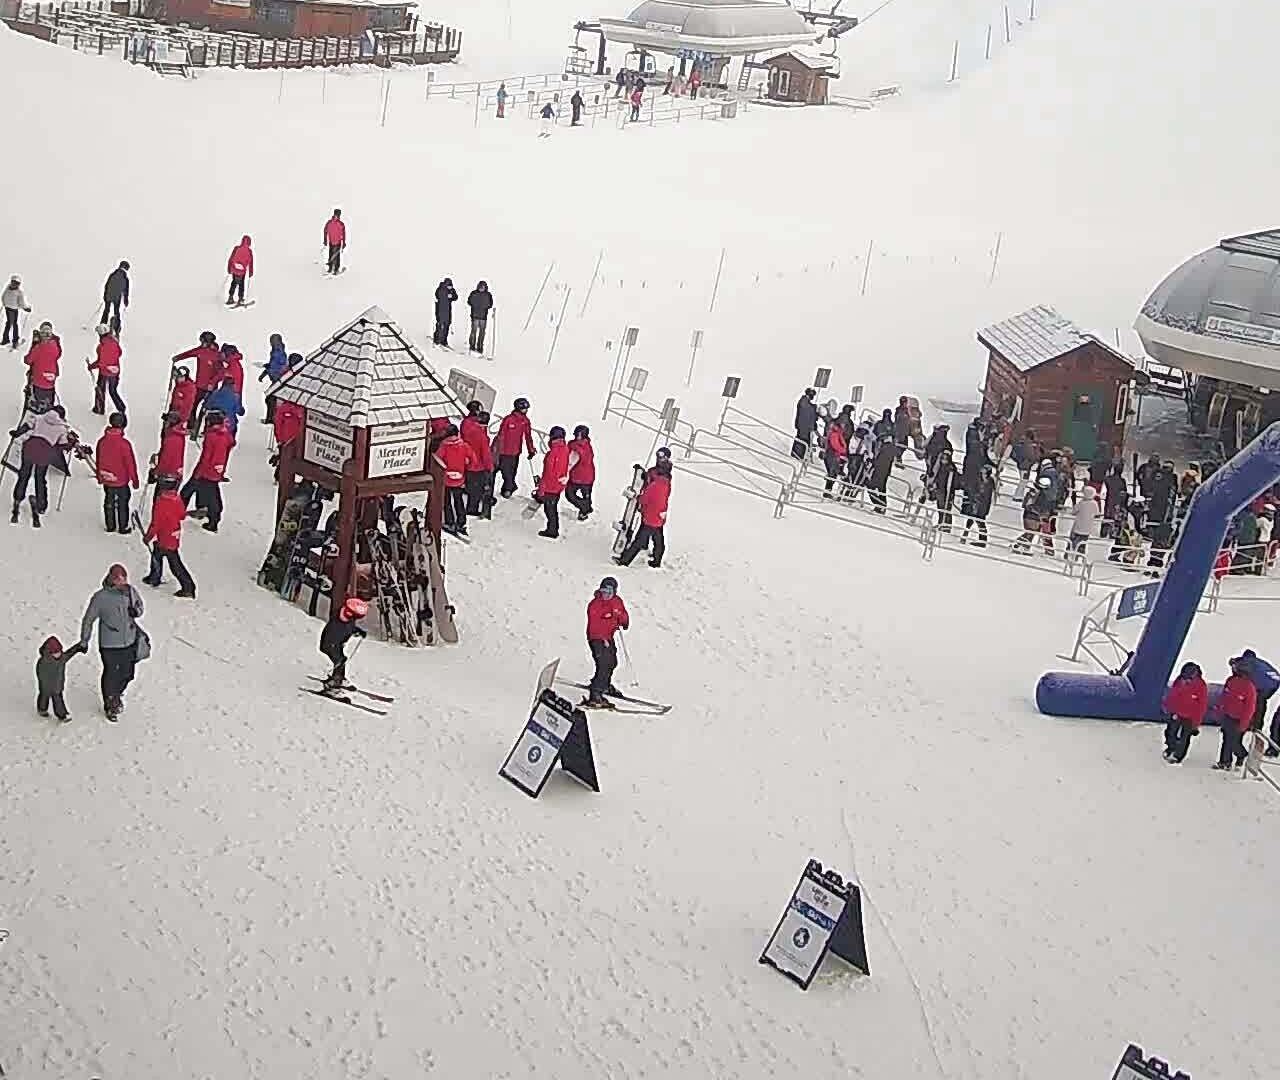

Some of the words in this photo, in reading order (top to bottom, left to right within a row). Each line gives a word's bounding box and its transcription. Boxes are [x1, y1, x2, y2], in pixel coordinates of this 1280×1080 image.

[312, 433, 346, 457] Meeting
[377, 445, 418, 460] Meeting
[316, 445, 341, 465] Place
[383, 457, 412, 469] Place
